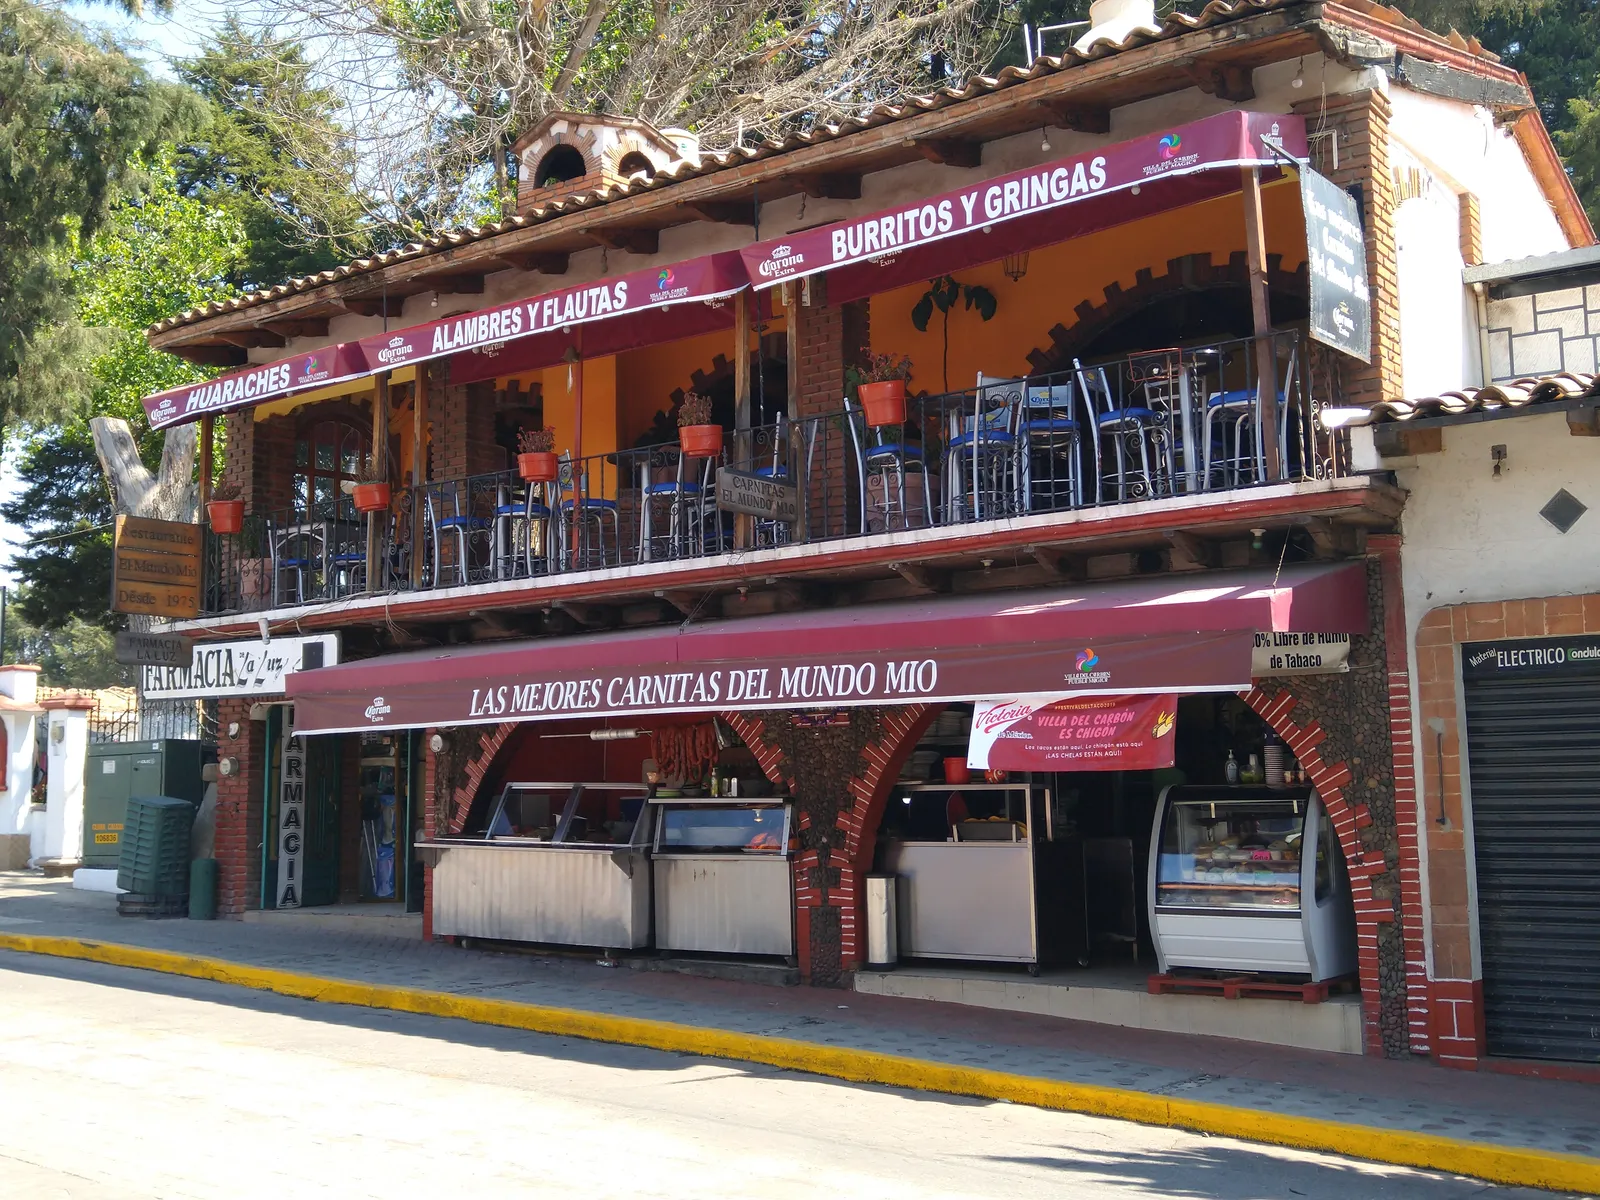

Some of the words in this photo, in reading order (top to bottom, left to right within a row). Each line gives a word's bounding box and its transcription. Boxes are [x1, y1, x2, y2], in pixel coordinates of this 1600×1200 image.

[832, 200, 952, 261] BURRITOS
[960, 191, 978, 225] Y
[984, 156, 1107, 218] GRINGAS
[758, 252, 804, 278] Corona
[775, 267, 795, 278] Extra
[432, 307, 522, 353] ALAMBRES
[527, 302, 540, 329] Y
[543, 281, 627, 327] FLAUTAS
[378, 344, 413, 363] Corona
[390, 355, 406, 364] Extra
[185, 363, 291, 412] HUARACHES
[151, 405, 177, 422] Corona
[733, 476, 785, 499] CARNITAS
[722, 488, 736, 504] EL
[738, 492, 773, 511] MUNDO
[121, 523, 194, 545] Restaurante
[129, 637, 182, 650] FARMACIA
[1273, 632, 1299, 647] Libre
[1302, 632, 1315, 646] de
[136, 651, 152, 661] LA
[155, 652, 177, 661] LUZ
[1270, 655, 1282, 669] de
[1285, 653, 1322, 669] Tabaco
[1468, 647, 1497, 668] Material
[1497, 647, 1565, 668] ELECTRICO
[144, 648, 236, 692] FARMACIA
[469, 686, 507, 716] LAS
[510, 679, 603, 713] MEJORES
[606, 670, 721, 707] CARNITAS
[726, 668, 772, 701] DEL
[778, 662, 876, 698] MUNDO
[884, 659, 938, 695] MIO
[364, 705, 391, 718] Corona
[976, 699, 1032, 733] Victoria
[1038, 715, 1068, 727] VILLA
[1071, 715, 1090, 727] DEL
[1095, 708, 1135, 727] CARBÓN
[1059, 728, 1074, 739] ES
